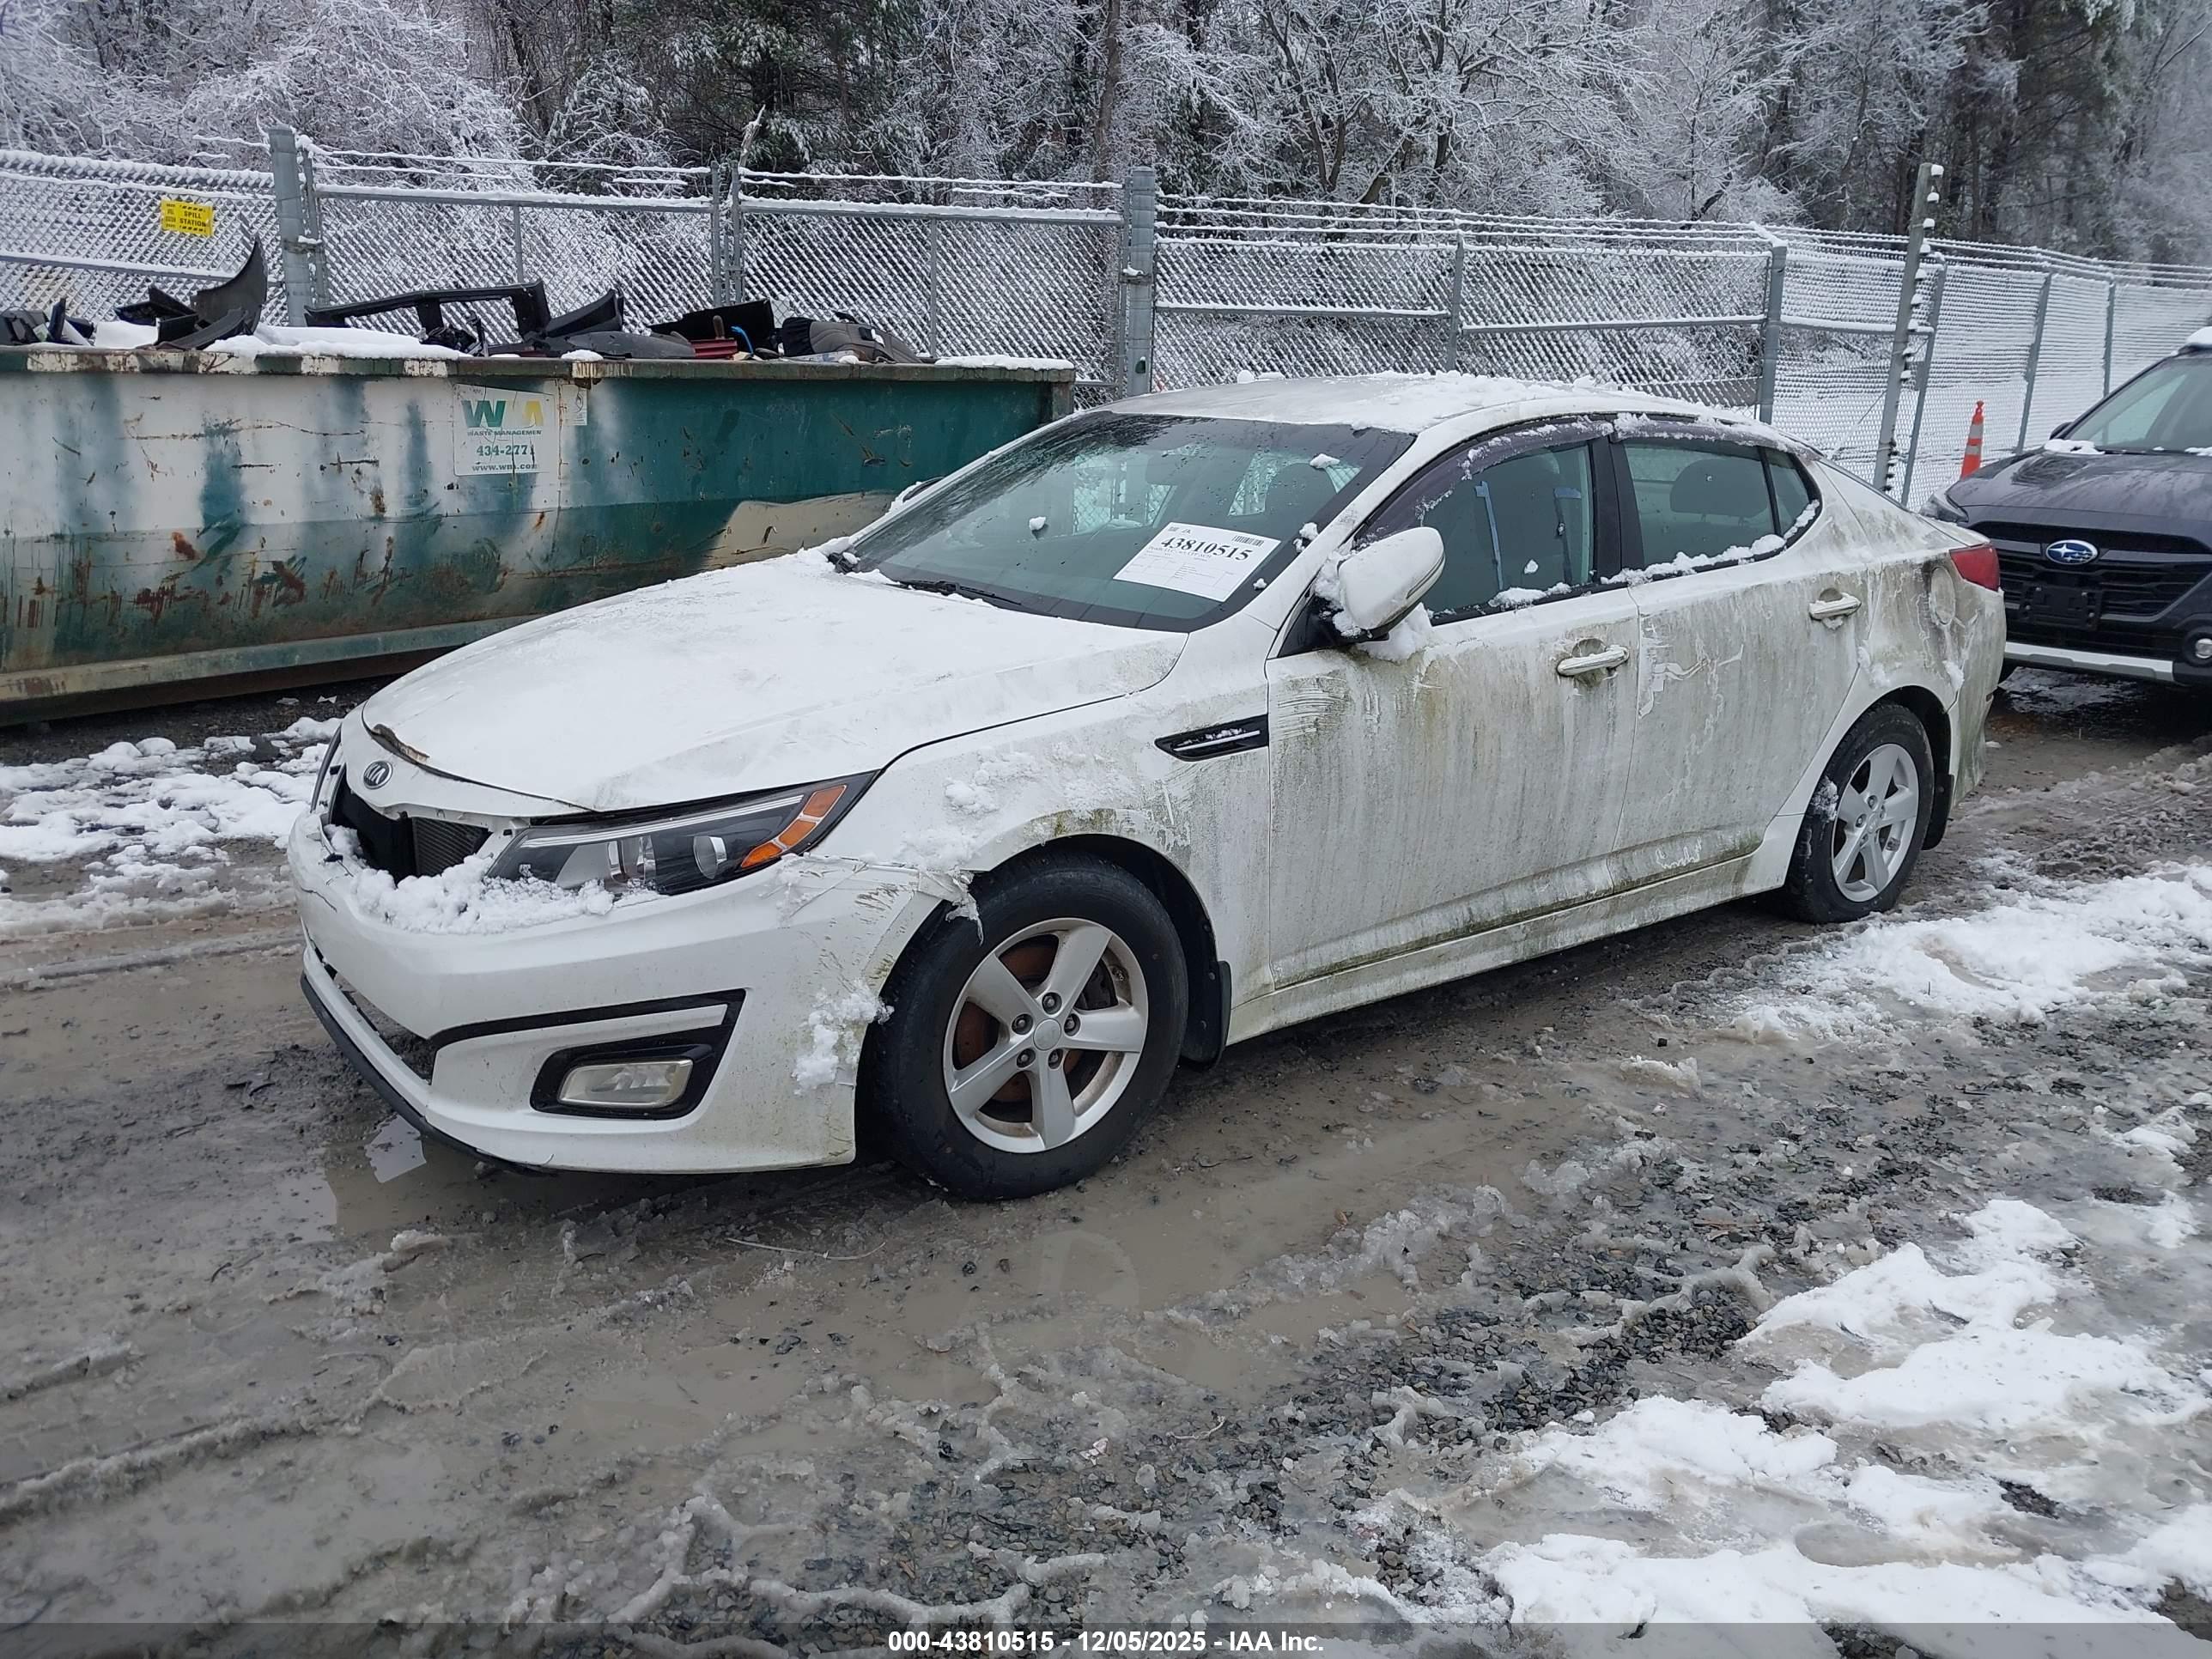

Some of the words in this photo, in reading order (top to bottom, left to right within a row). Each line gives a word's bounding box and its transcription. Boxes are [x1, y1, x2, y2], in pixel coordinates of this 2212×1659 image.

[184, 210, 201, 219] SPILL
[179, 218, 206, 227] STATION
[1161, 537, 1255, 562] 43810515
